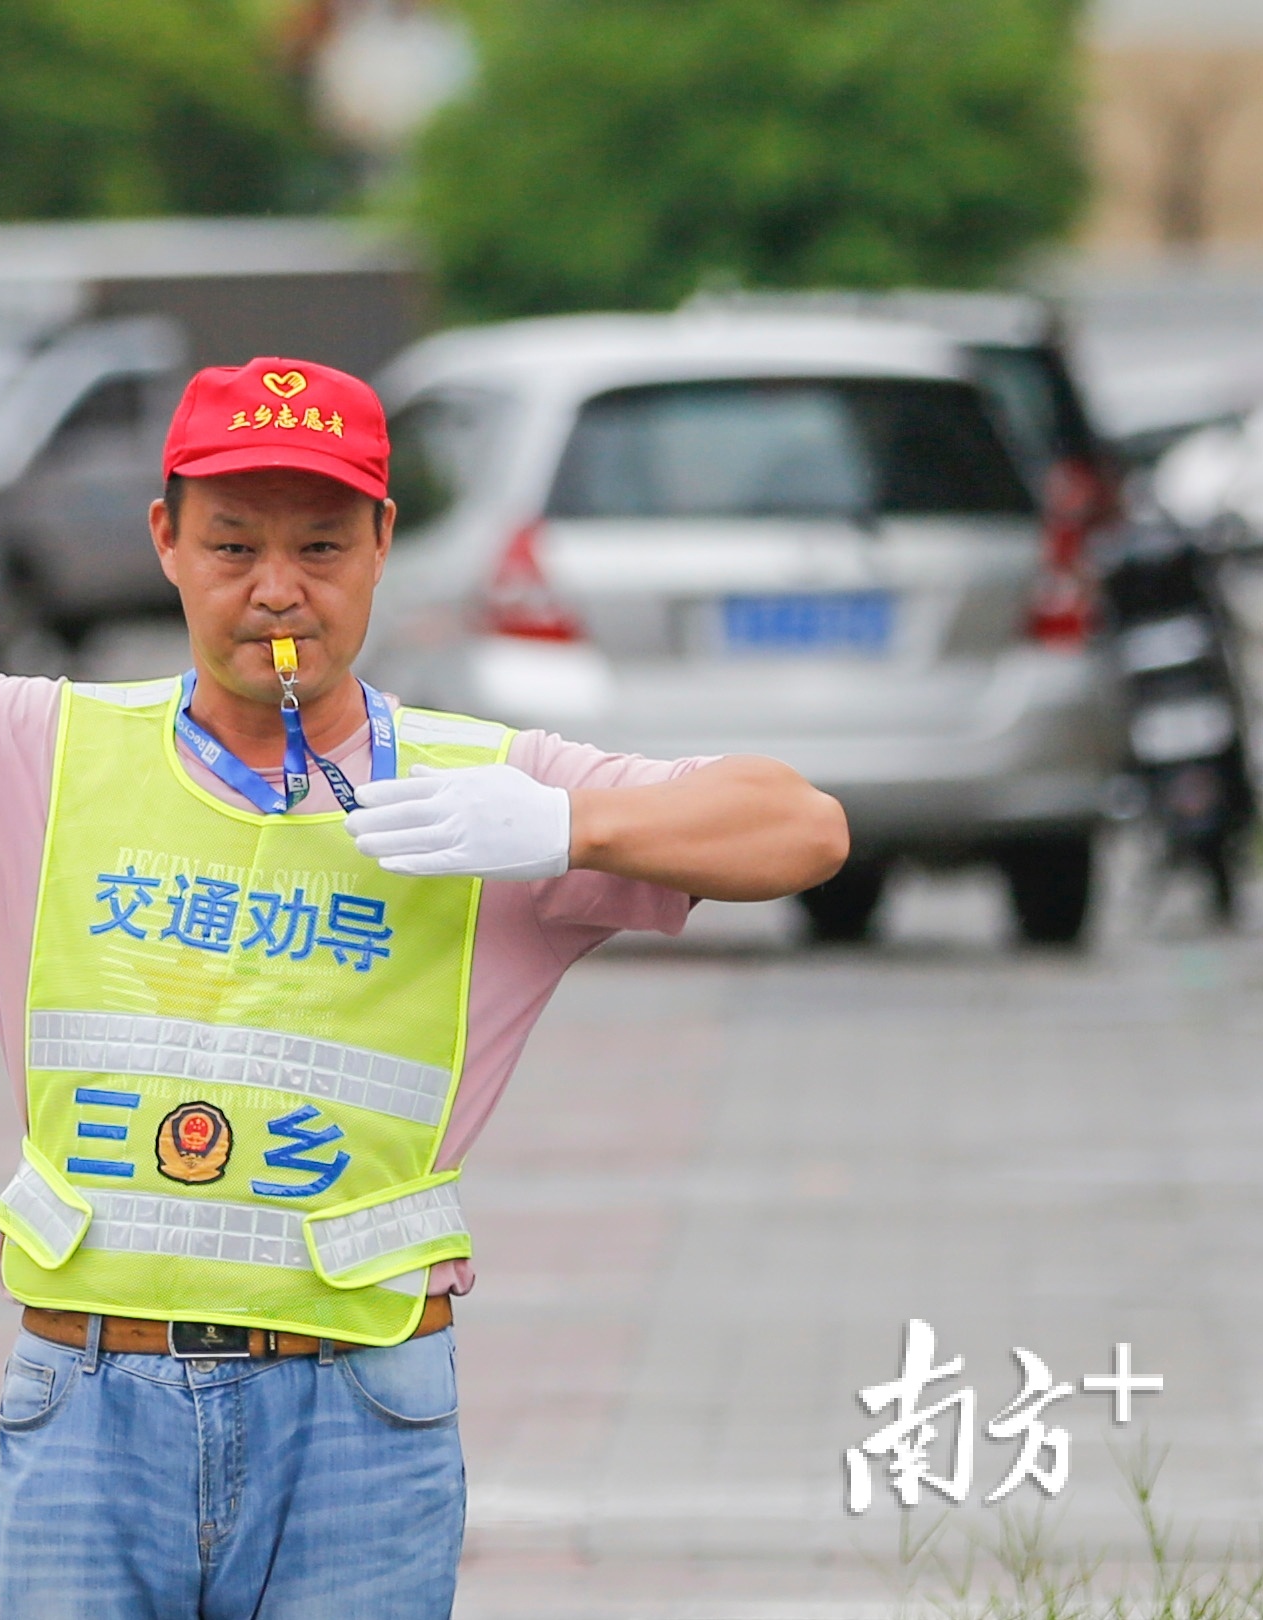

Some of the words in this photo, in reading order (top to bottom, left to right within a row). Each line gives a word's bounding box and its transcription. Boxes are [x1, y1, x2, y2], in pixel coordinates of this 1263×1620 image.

[227, 403, 344, 438] 三乡志愿者
[89, 865, 394, 972] 交通劝导
[66, 1087, 141, 1178] 三
[250, 1104, 352, 1197] 乡
